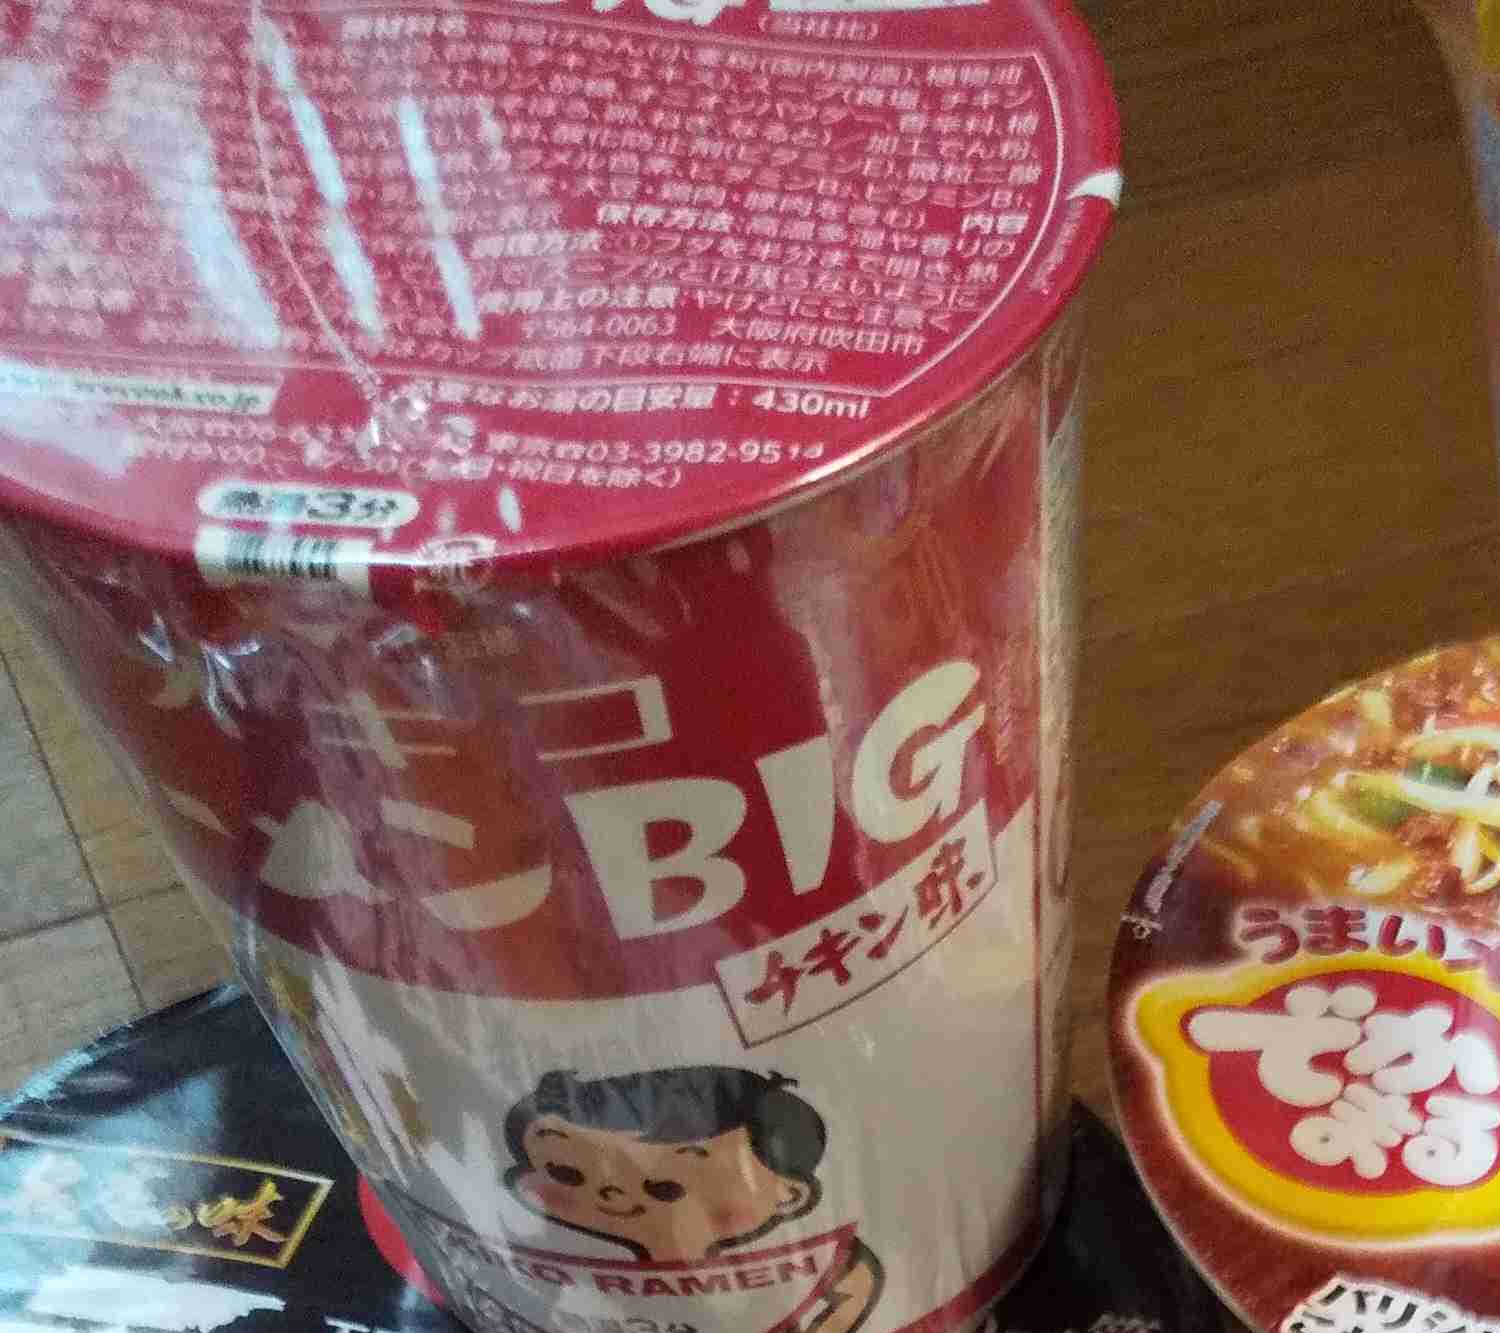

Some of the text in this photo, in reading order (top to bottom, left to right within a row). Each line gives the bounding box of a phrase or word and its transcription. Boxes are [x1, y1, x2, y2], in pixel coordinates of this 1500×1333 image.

[562, 660, 987, 941] BIG
[744, 832, 985, 1014] チキン味
[593, 1253, 820, 1298] RAMEN
